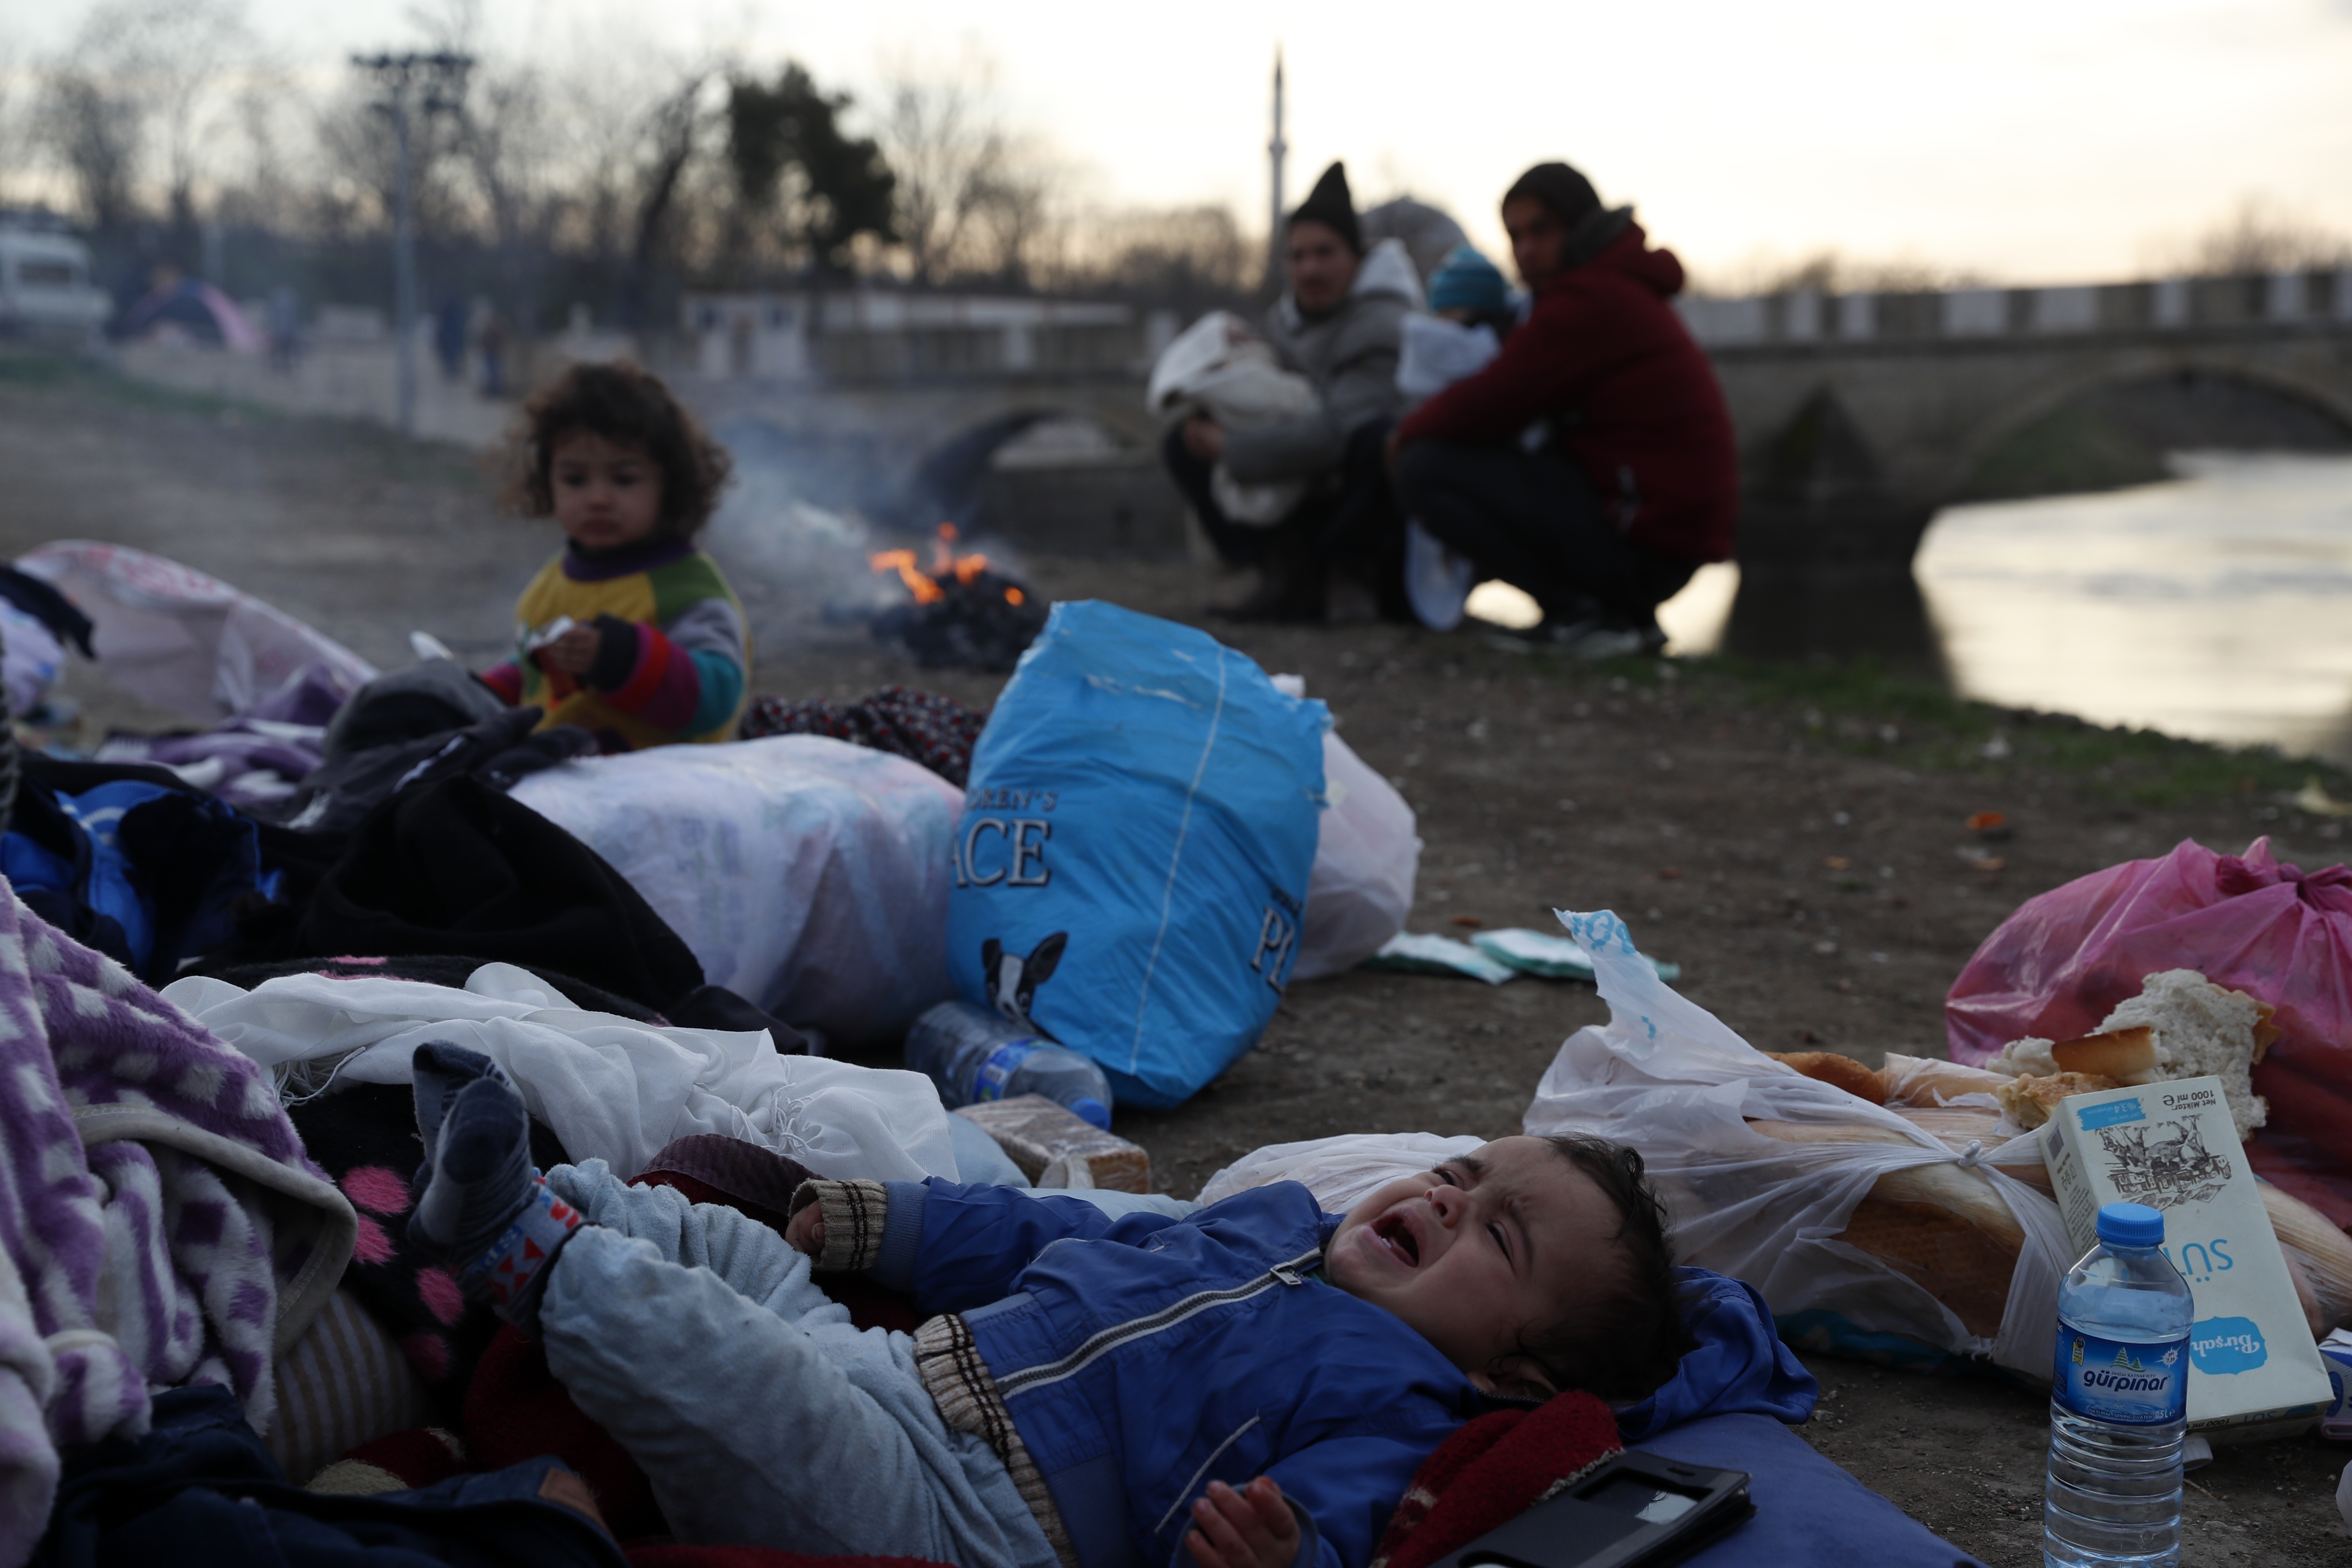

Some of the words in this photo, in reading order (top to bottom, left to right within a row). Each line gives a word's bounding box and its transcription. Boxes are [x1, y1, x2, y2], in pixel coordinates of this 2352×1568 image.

[2177, 1094, 2188, 1103] ml
[2192, 1090, 2214, 1100] 1000
[2171, 1101, 2200, 1110] Miktar:
[2191, 1334, 2260, 1357] Birşah
[2083, 1370, 2168, 1392] gürpınar
[2089, 1408, 2110, 1416] NATURAL
